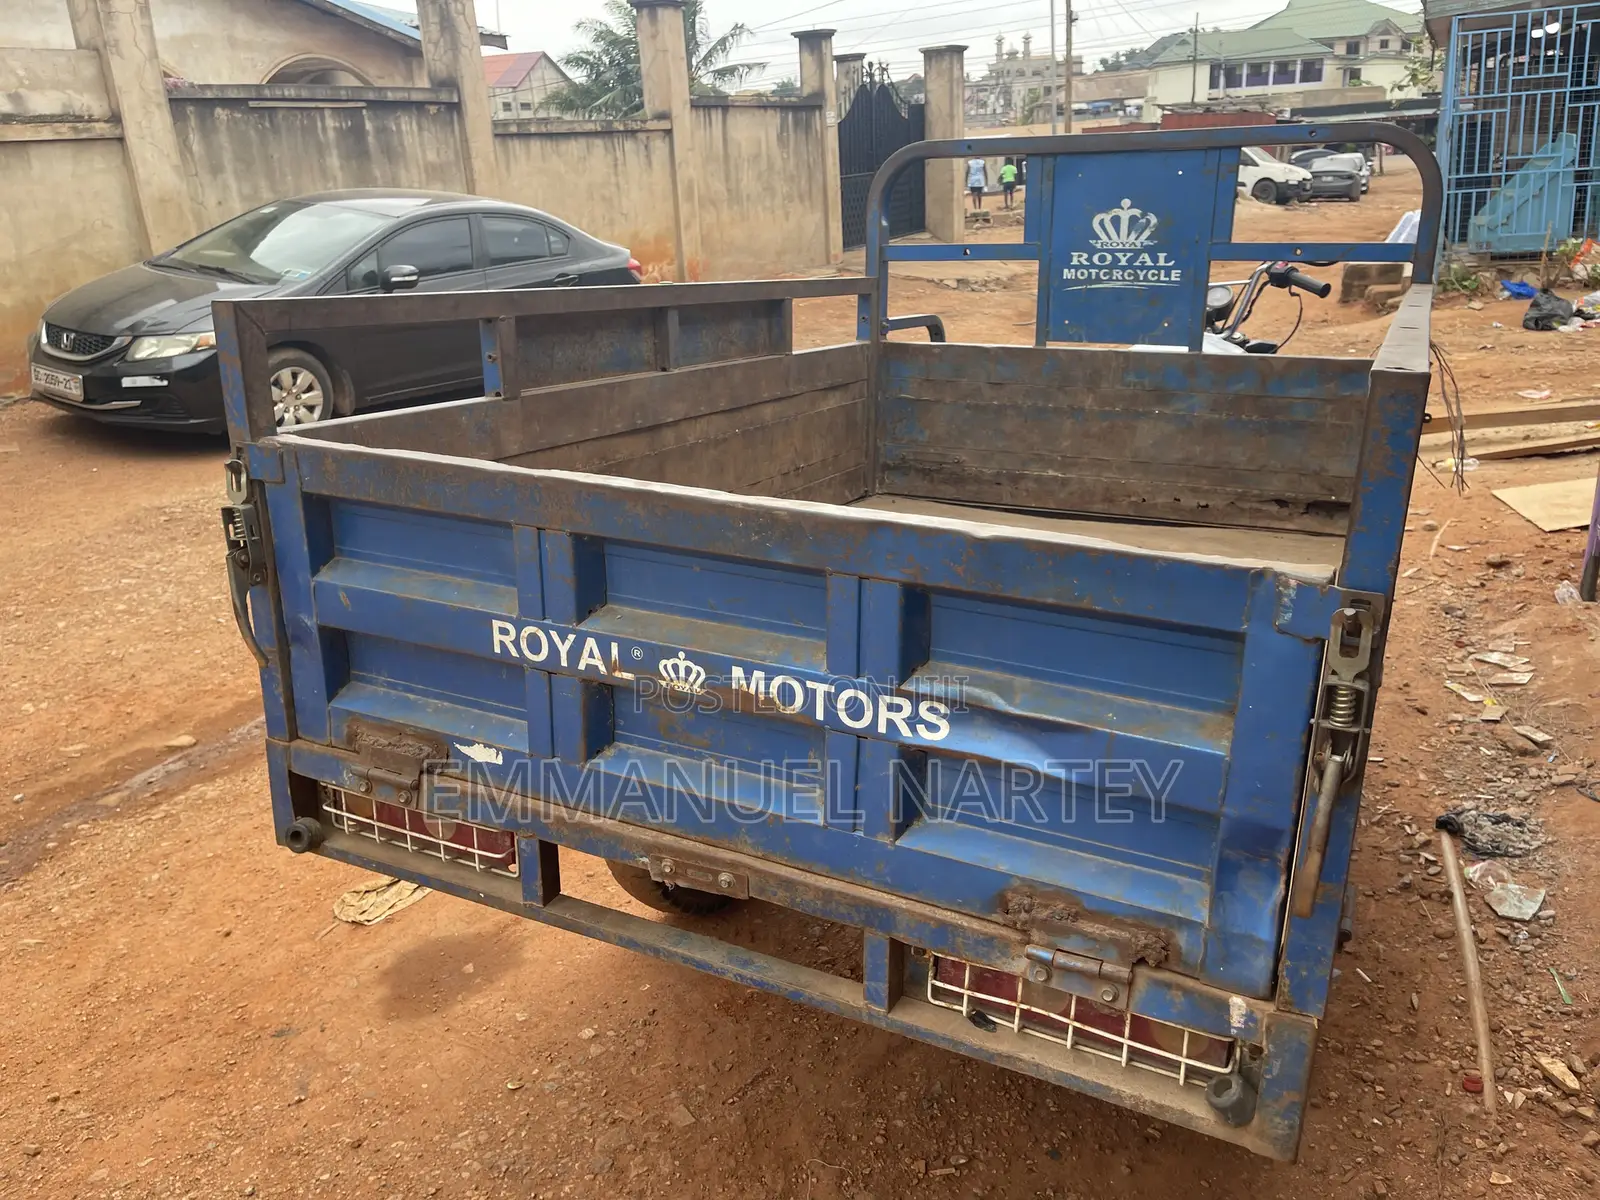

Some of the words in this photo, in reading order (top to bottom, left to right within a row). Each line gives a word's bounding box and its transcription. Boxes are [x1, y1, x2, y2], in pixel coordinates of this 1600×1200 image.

[1070, 252, 1176, 266] ROYAL
[491, 619, 635, 680] ROYAL
[731, 665, 950, 741] MOTORS
